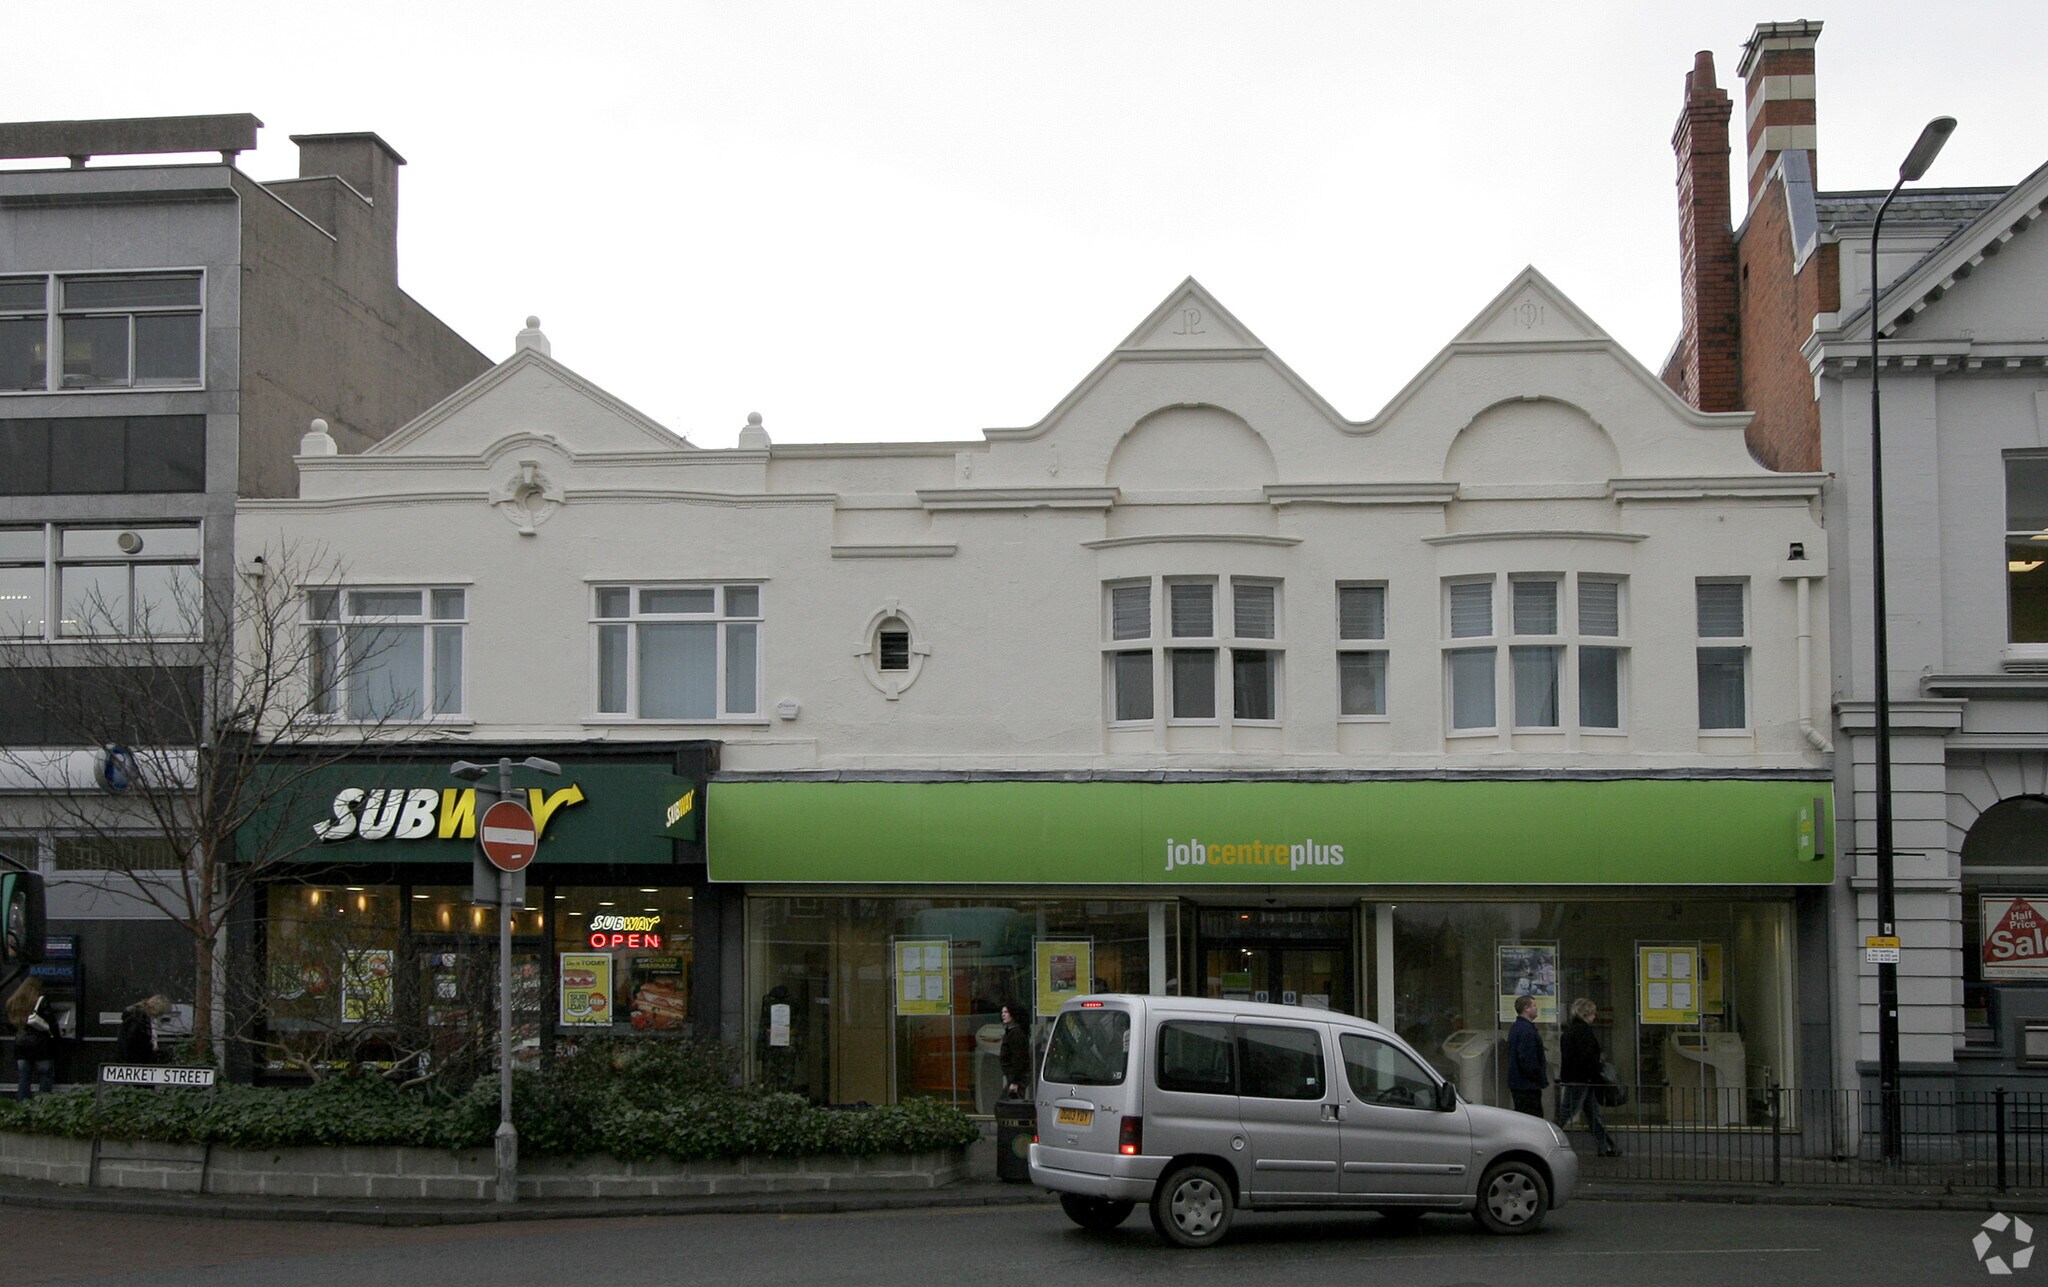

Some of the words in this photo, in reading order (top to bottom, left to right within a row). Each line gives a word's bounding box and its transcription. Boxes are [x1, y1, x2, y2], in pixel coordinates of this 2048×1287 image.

[313, 783, 583, 841] SUBWY
[666, 789, 695, 828] SUBWAY
[1165, 838, 1344, 871] jobcentreplus
[590, 915, 660, 931] SUBWAY
[2010, 911, 2032, 920] Half
[2009, 920, 2037, 929] Price
[591, 933, 659, 948] OPEN
[1991, 927, 2048, 958] Sal
[30, 966, 74, 976] BARCLAYS
[106, 1067, 157, 1081] MARKET
[163, 1069, 211, 1084] STREET
